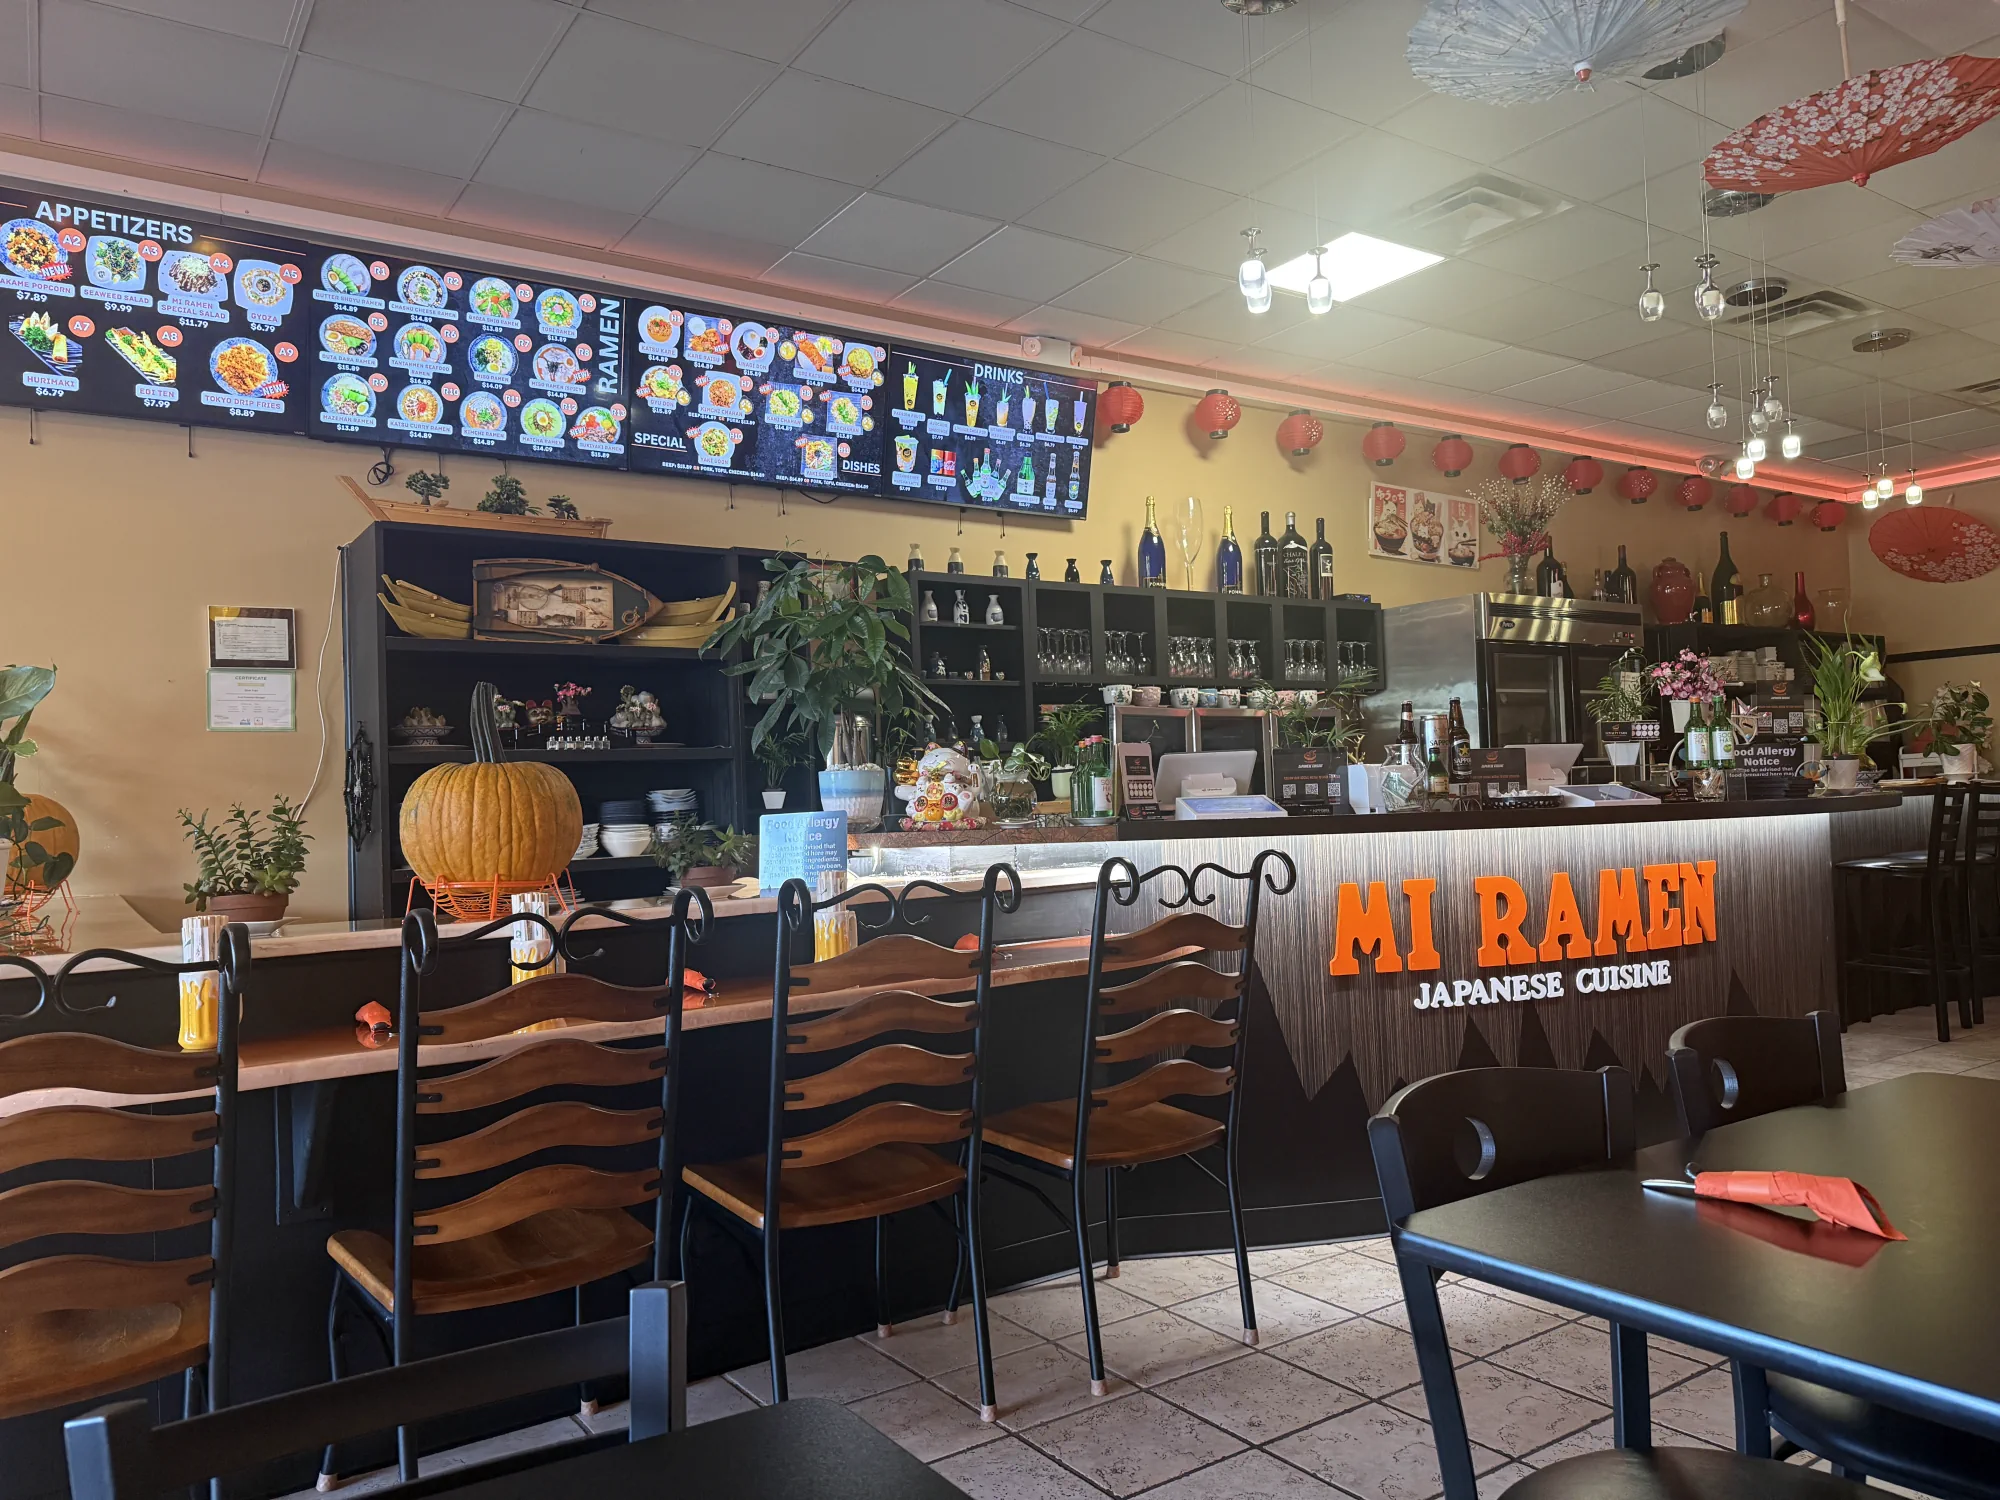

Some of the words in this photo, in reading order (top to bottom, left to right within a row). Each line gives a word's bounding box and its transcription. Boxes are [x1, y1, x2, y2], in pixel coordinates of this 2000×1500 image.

[35, 201, 194, 244] APPETIZERS
[62, 234, 81, 246] A2
[141, 245, 159, 256] A3
[213, 258, 229, 269] A4
[41, 263, 69, 278] NEW!
[282, 269, 298, 280] A5
[374, 266, 386, 276] R1
[446, 276, 459, 285] R2
[31, 280, 71, 293] POPCORN
[16, 290, 48, 302] $7.89
[83, 288, 122, 301] SEAWEED
[123, 294, 149, 305] SALAD
[518, 289, 530, 298] R3
[104, 301, 132, 312] $9.99
[172, 297, 182, 305] MI
[184, 299, 213, 309] RAMEN
[333, 303, 358, 313] $14.89
[361, 298, 383, 307] RAMEN
[581, 299, 593, 307] R4
[161, 304, 198, 316] SPECIAL
[199, 310, 226, 320] SALAD
[250, 312, 279, 323] GYOZA
[437, 309, 456, 318] RAMEN
[179, 317, 208, 329] $11.79
[371, 317, 384, 327] R5
[410, 314, 433, 323] $14.89
[73, 320, 91, 332] A7
[250, 322, 276, 333] $6.79
[161, 332, 178, 342] A8
[443, 329, 456, 338] R6
[518, 339, 530, 348] R7
[598, 298, 620, 394] RAMEN
[278, 348, 294, 357] A9
[578, 348, 590, 357] R8
[974, 363, 1024, 385] DRINKS
[27, 375, 76, 388] HURIMAKI
[372, 378, 385, 388] R9
[35, 387, 64, 398] $6.79
[158, 389, 175, 398] TEN
[262, 383, 287, 397] NEW!
[442, 387, 459, 396] R10
[143, 399, 170, 409] $7.99
[204, 394, 232, 405] TOKYO
[234, 398, 254, 407] DRIP
[256, 400, 281, 410] FRIES
[505, 395, 520, 403] R11
[229, 407, 255, 418] $8.89
[409, 431, 433, 440] $14.89
[634, 432, 687, 449] SPECIAL
[842, 460, 880, 474] DISHES
[1734, 748, 1754, 756] ood
[1756, 746, 1797, 757] Allergy
[1743, 757, 1780, 766] Notice
[797, 816, 840, 830] Allergy
[1330, 878, 1441, 976] MI
[1473, 859, 1717, 968] RAMEN
[1413, 970, 1564, 1010] JAPANESE
[1575, 959, 1672, 994] CUISINE
